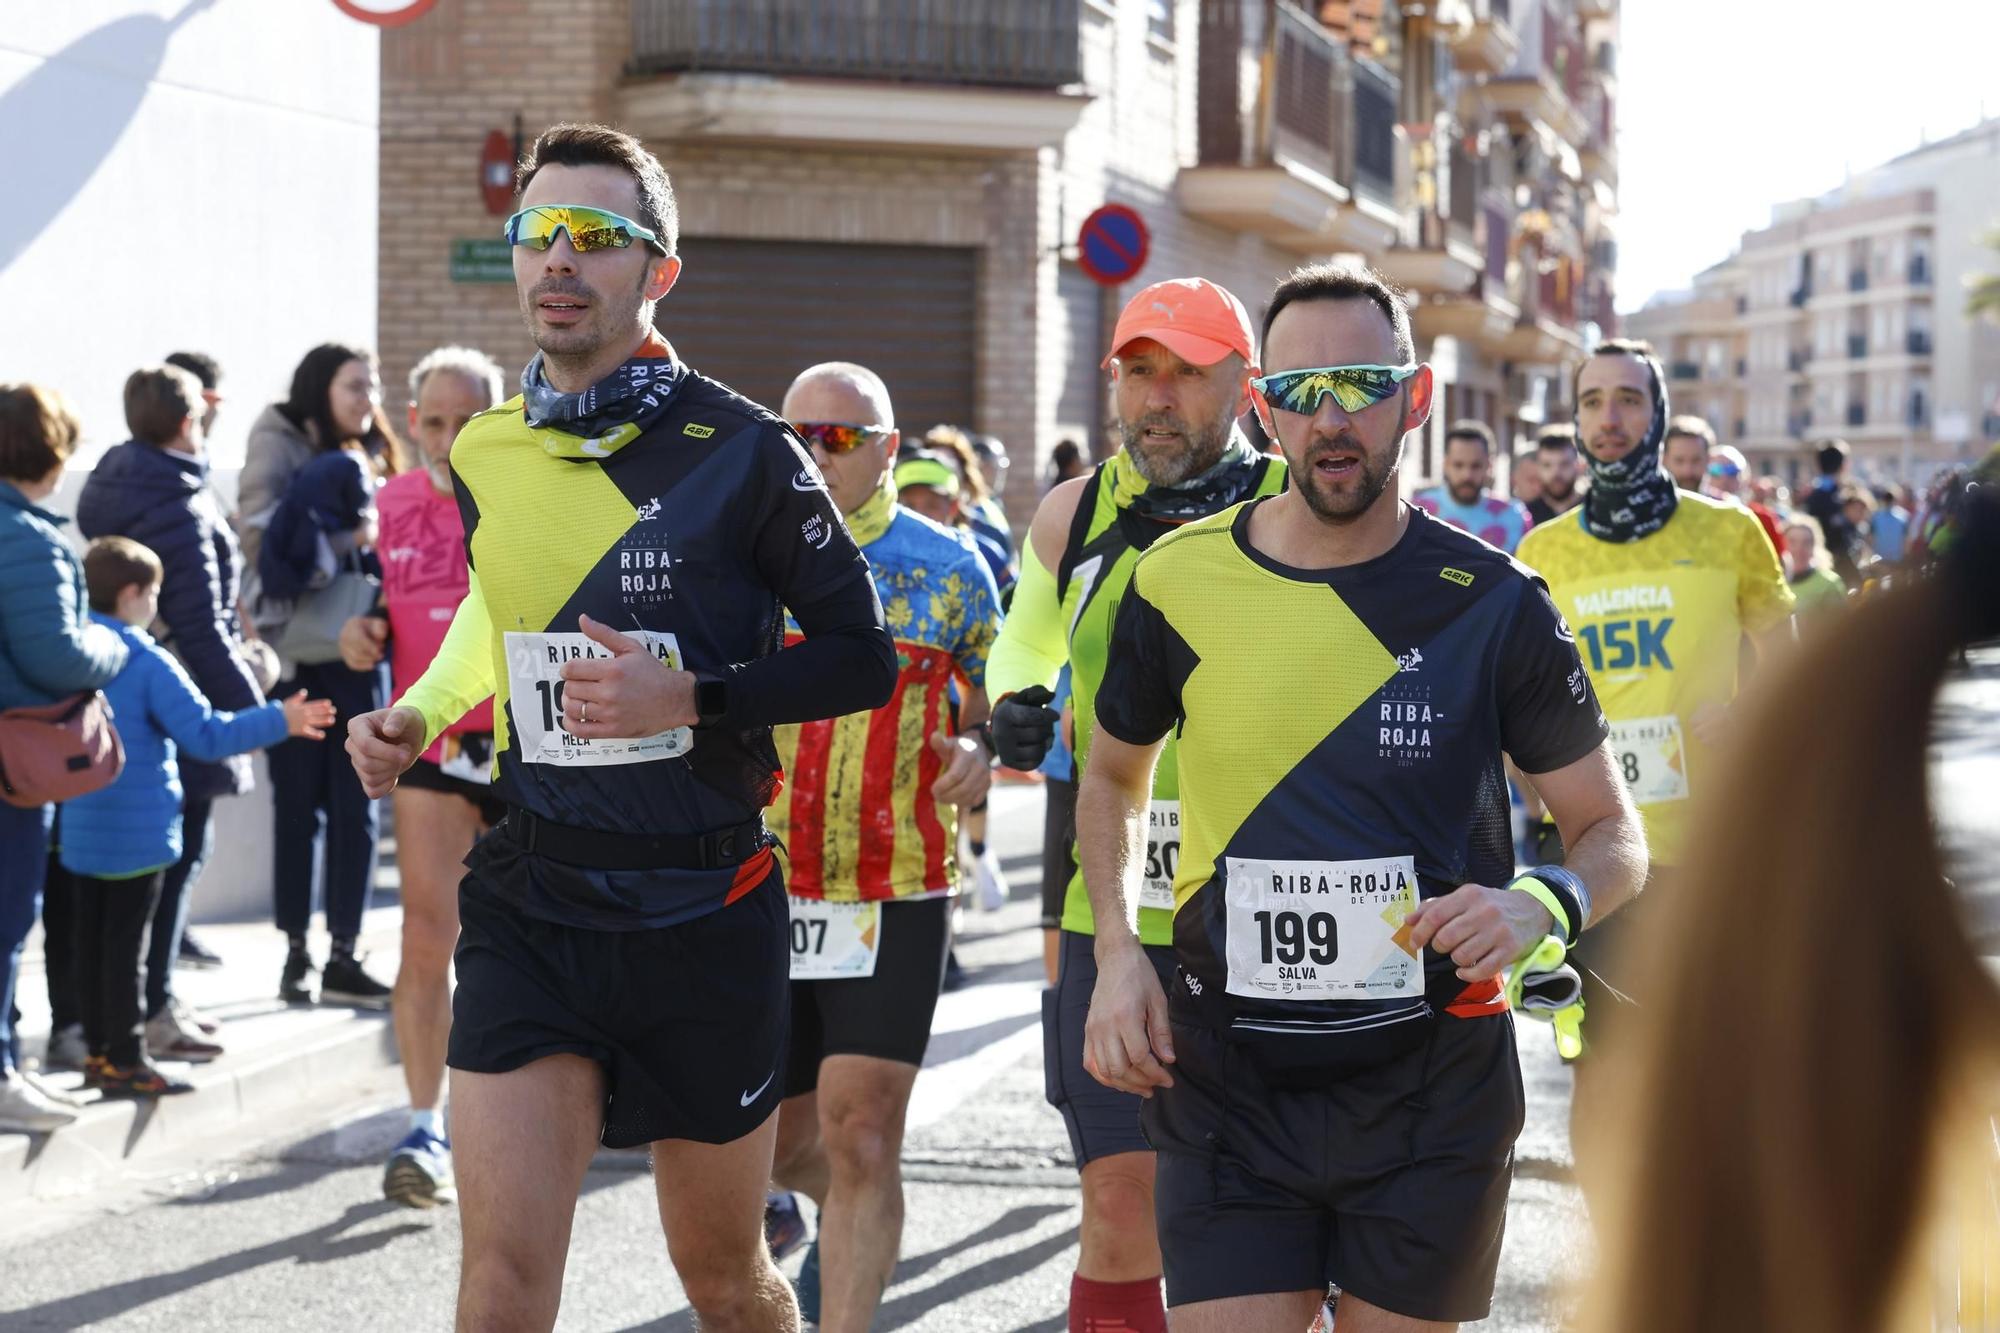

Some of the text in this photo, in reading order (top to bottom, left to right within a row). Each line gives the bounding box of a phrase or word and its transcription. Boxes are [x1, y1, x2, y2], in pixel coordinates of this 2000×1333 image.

[686, 426, 712, 437] 42K
[801, 513, 822, 533] SOM
[804, 528, 821, 543] RIU
[621, 551, 683, 569] RIBA-
[621, 572, 672, 594] RØJA
[1443, 570, 1471, 584] 42K
[623, 593, 674, 604] DE TÚRIA
[1573, 584, 1675, 617] VALENCIA
[1578, 617, 1674, 672] 15K
[1380, 703, 1444, 722] RIBA-
[1379, 726, 1431, 748] RØJA
[1379, 748, 1431, 758] DE TÚRIA
[1351, 893, 1409, 905] DE TÚRIA
[1254, 911, 1338, 966] 199
[1278, 967, 1317, 980] SALVA
